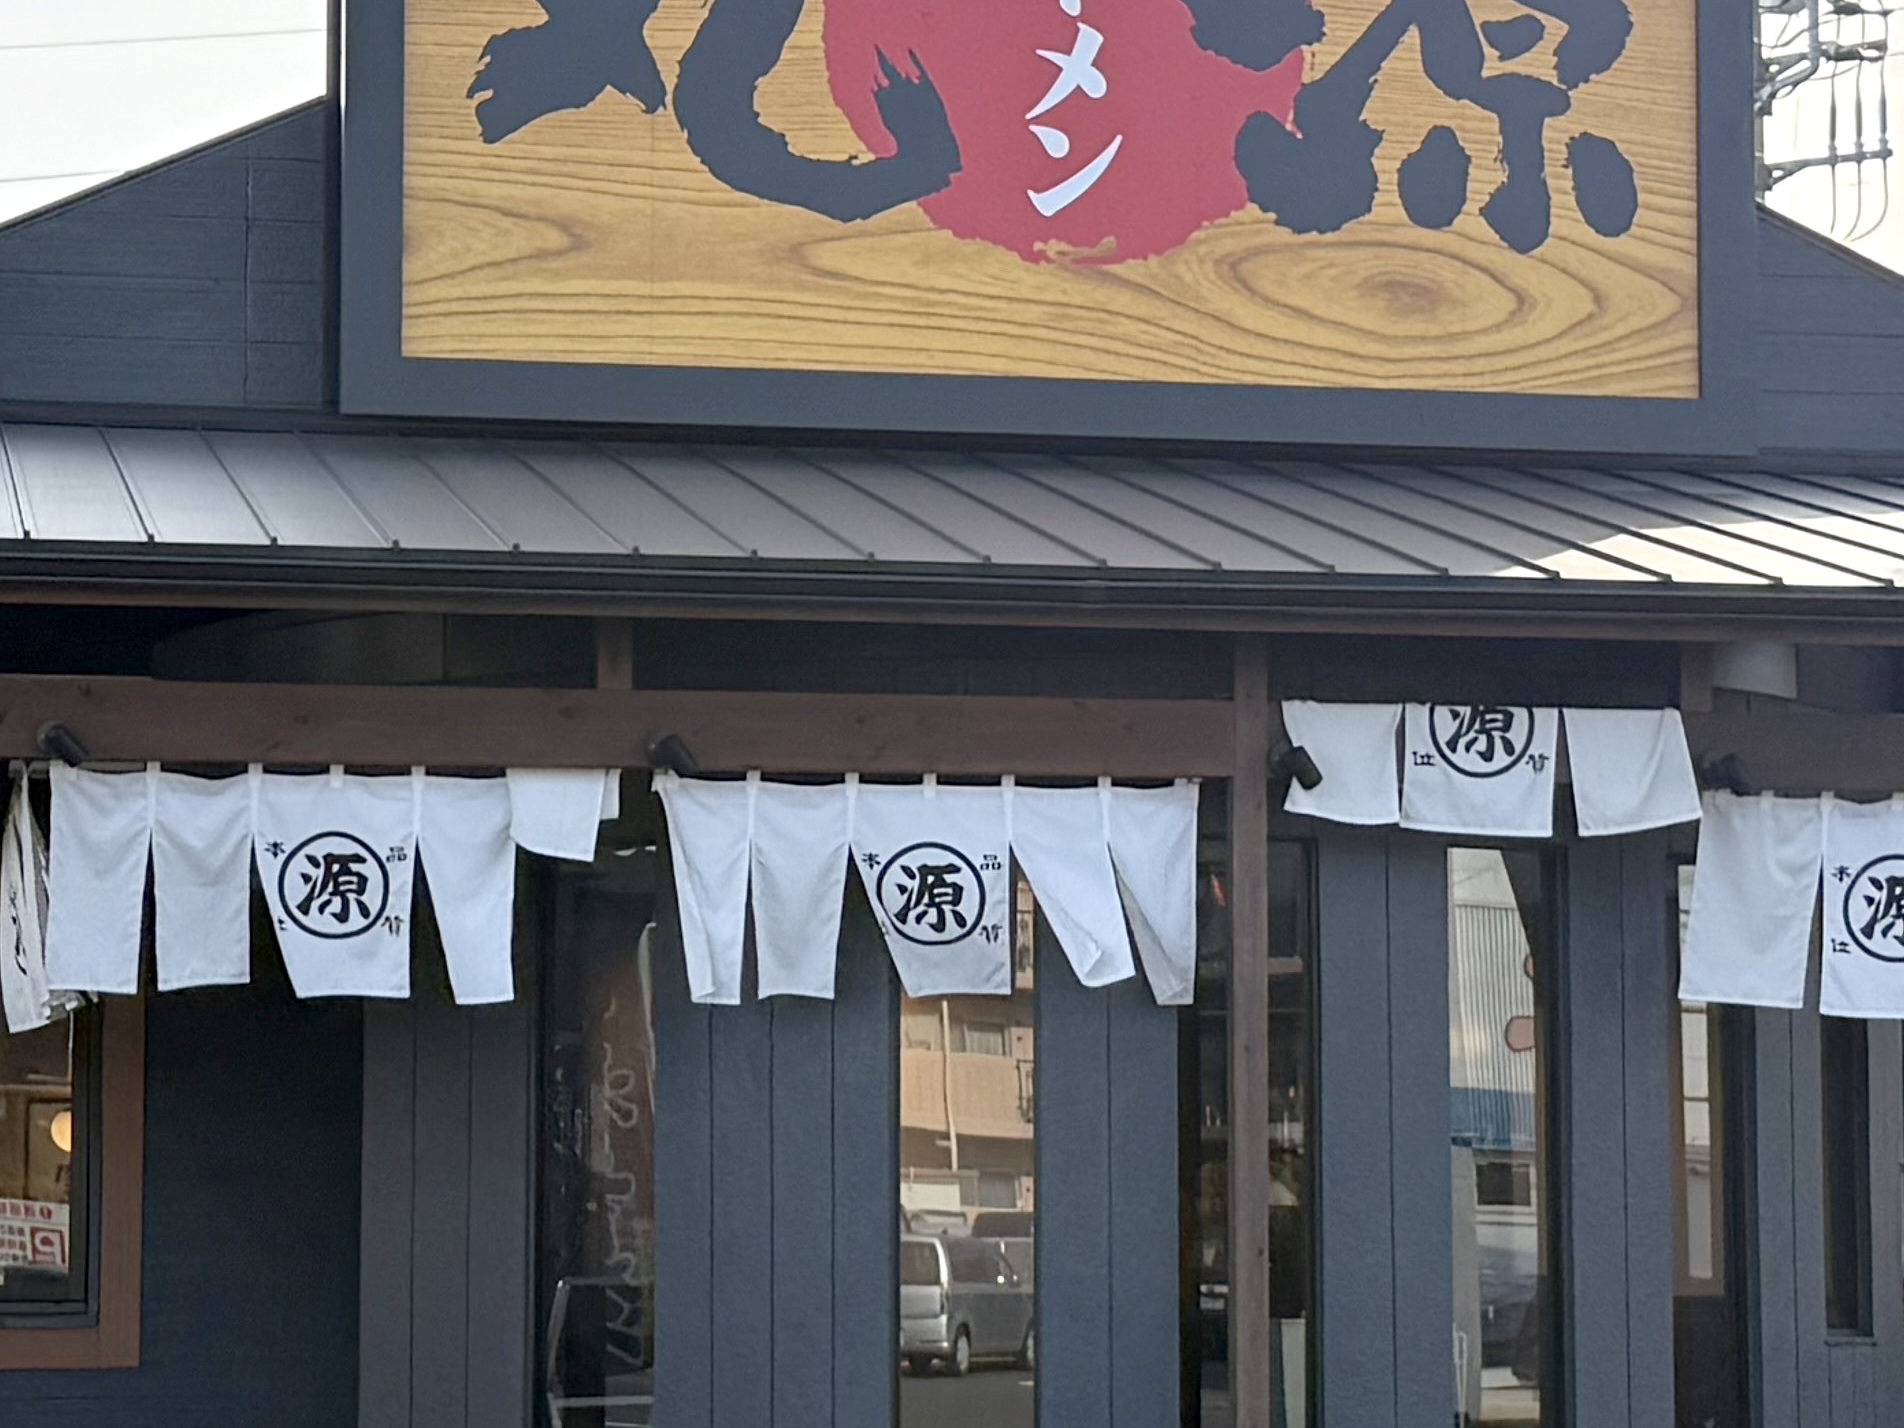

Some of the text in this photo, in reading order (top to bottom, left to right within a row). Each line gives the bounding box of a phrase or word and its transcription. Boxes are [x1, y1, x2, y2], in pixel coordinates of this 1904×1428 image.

[1445, 706, 1517, 763] 源
[295, 851, 372, 925] 源
[892, 862, 968, 935] 源
